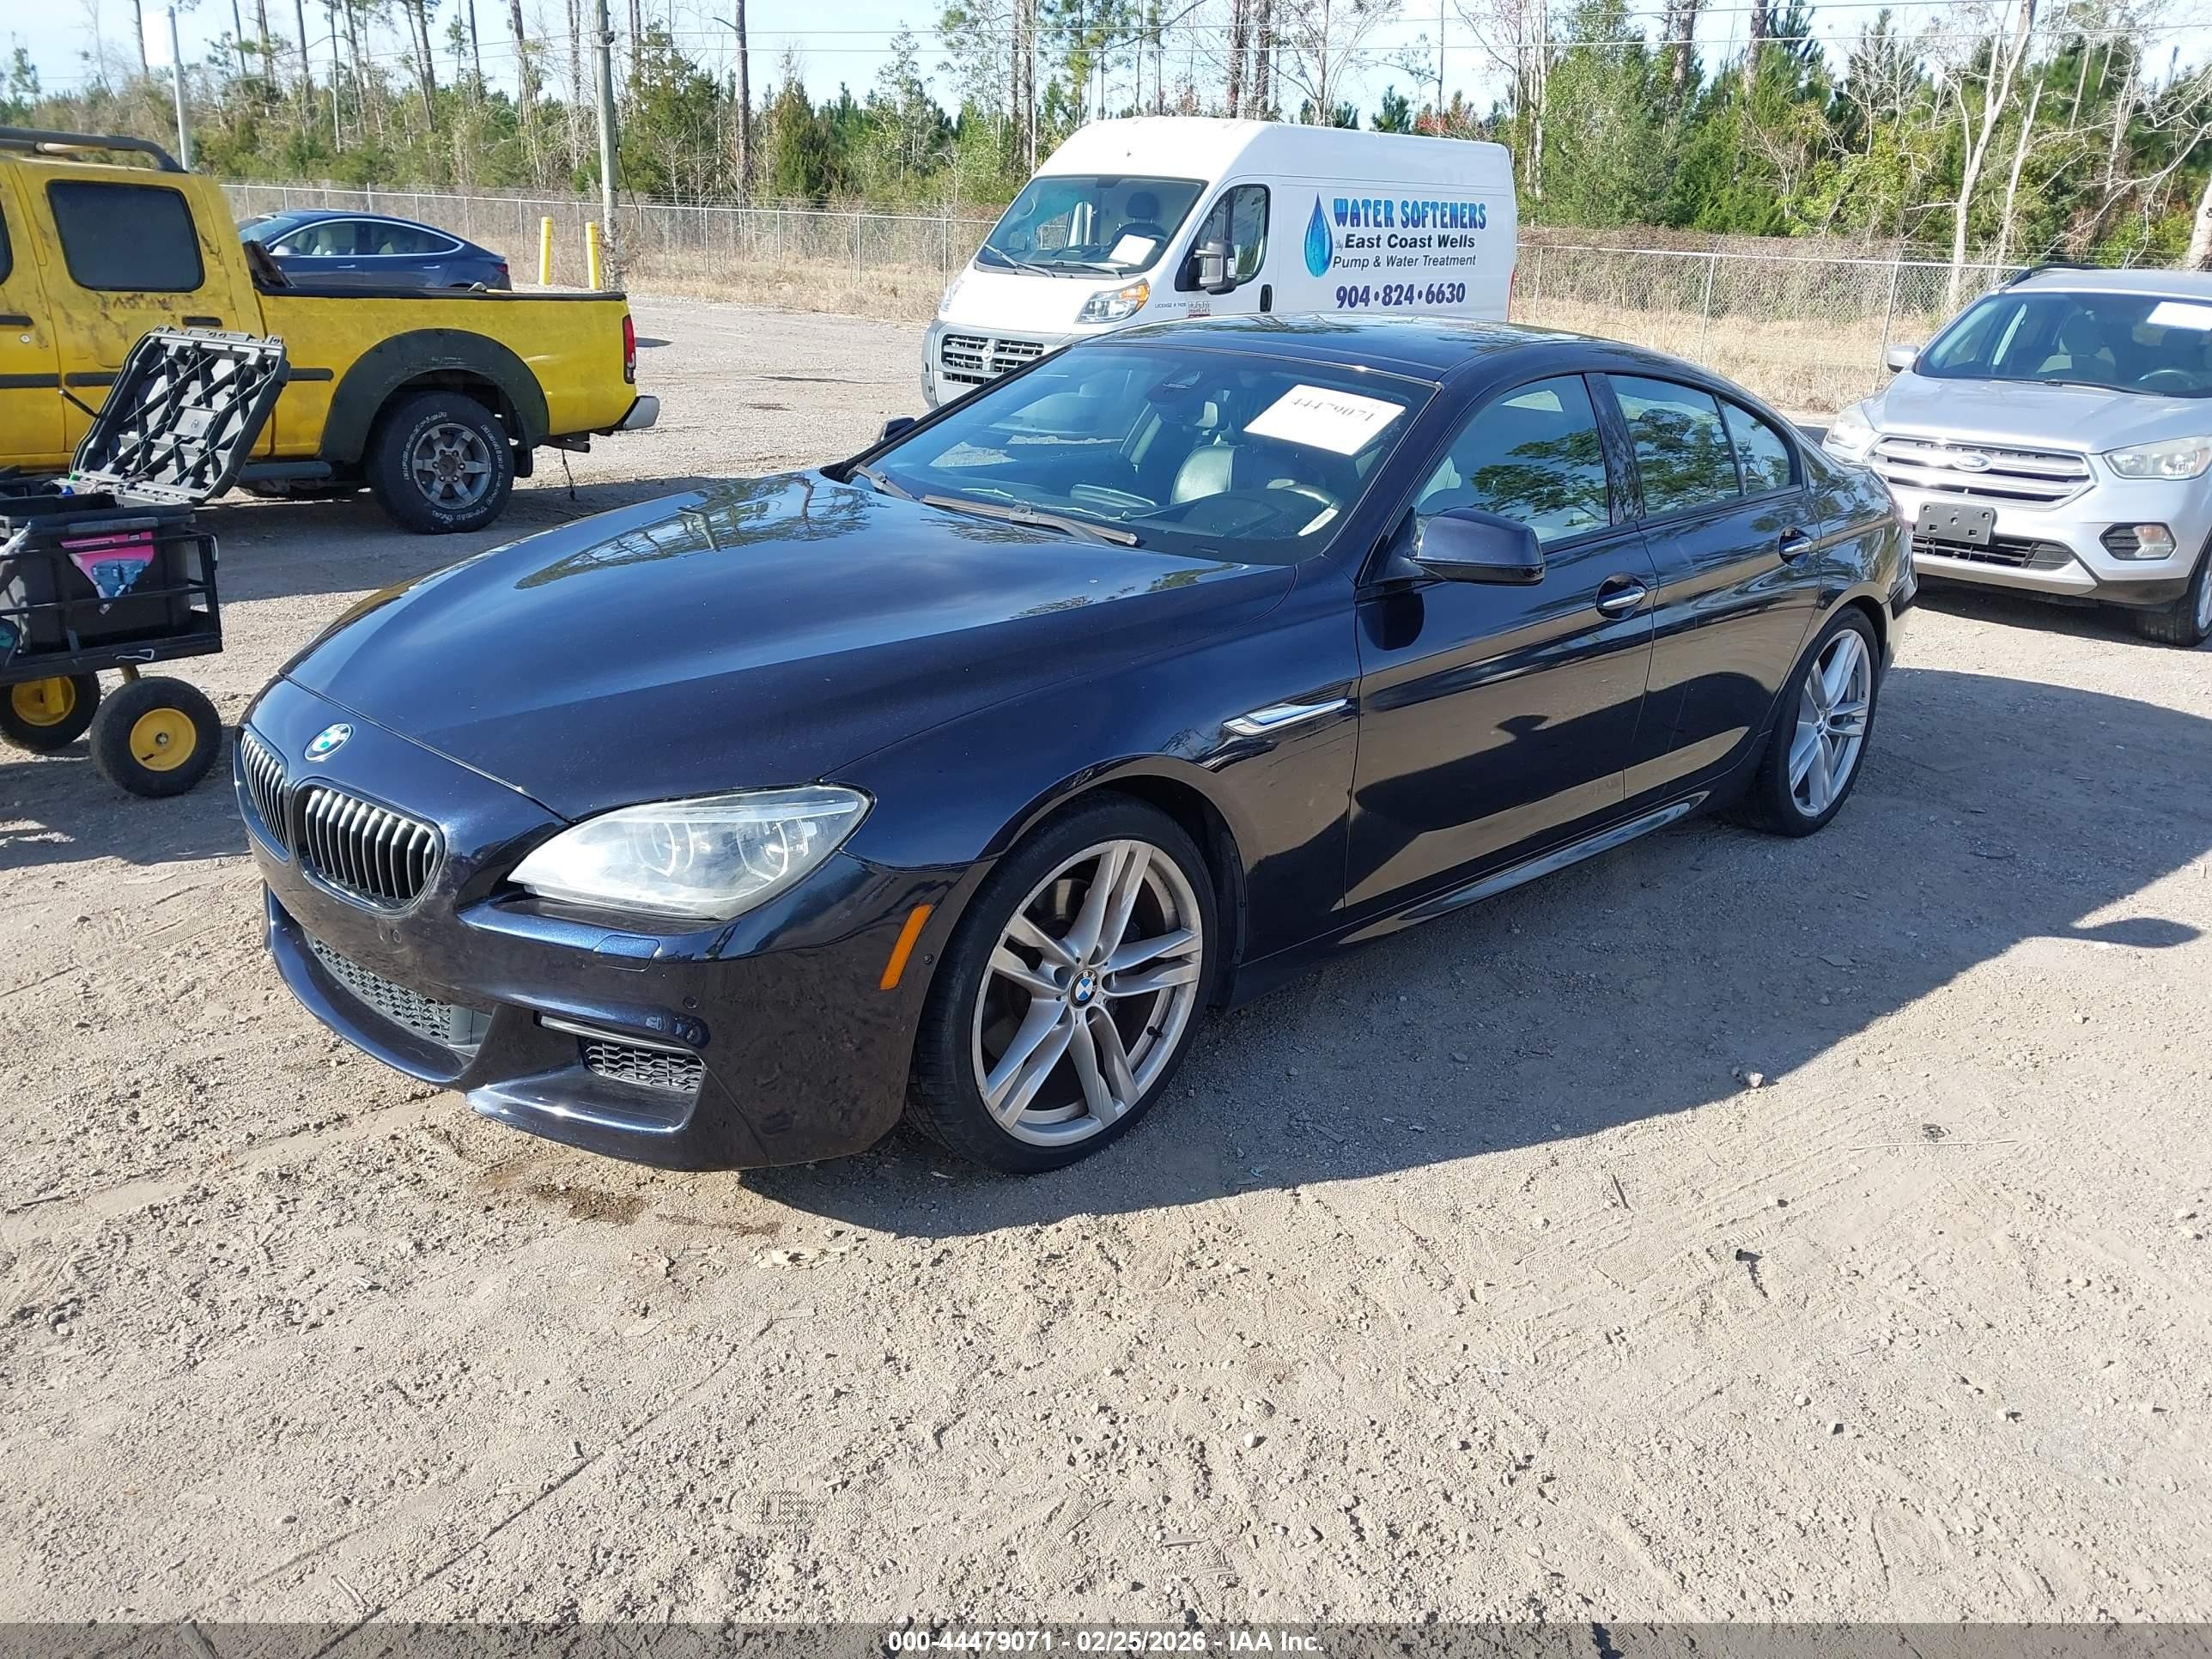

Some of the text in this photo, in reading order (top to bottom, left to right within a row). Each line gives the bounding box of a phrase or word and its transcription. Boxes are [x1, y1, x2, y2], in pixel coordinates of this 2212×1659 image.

[1333, 198, 1487, 229] WATER SOFTENERS
[1345, 234, 1382, 248] East
[1387, 234, 1433, 248] Coast
[1437, 234, 1475, 248] Wells
[1333, 254, 1476, 270] Pump & Water Treatment
